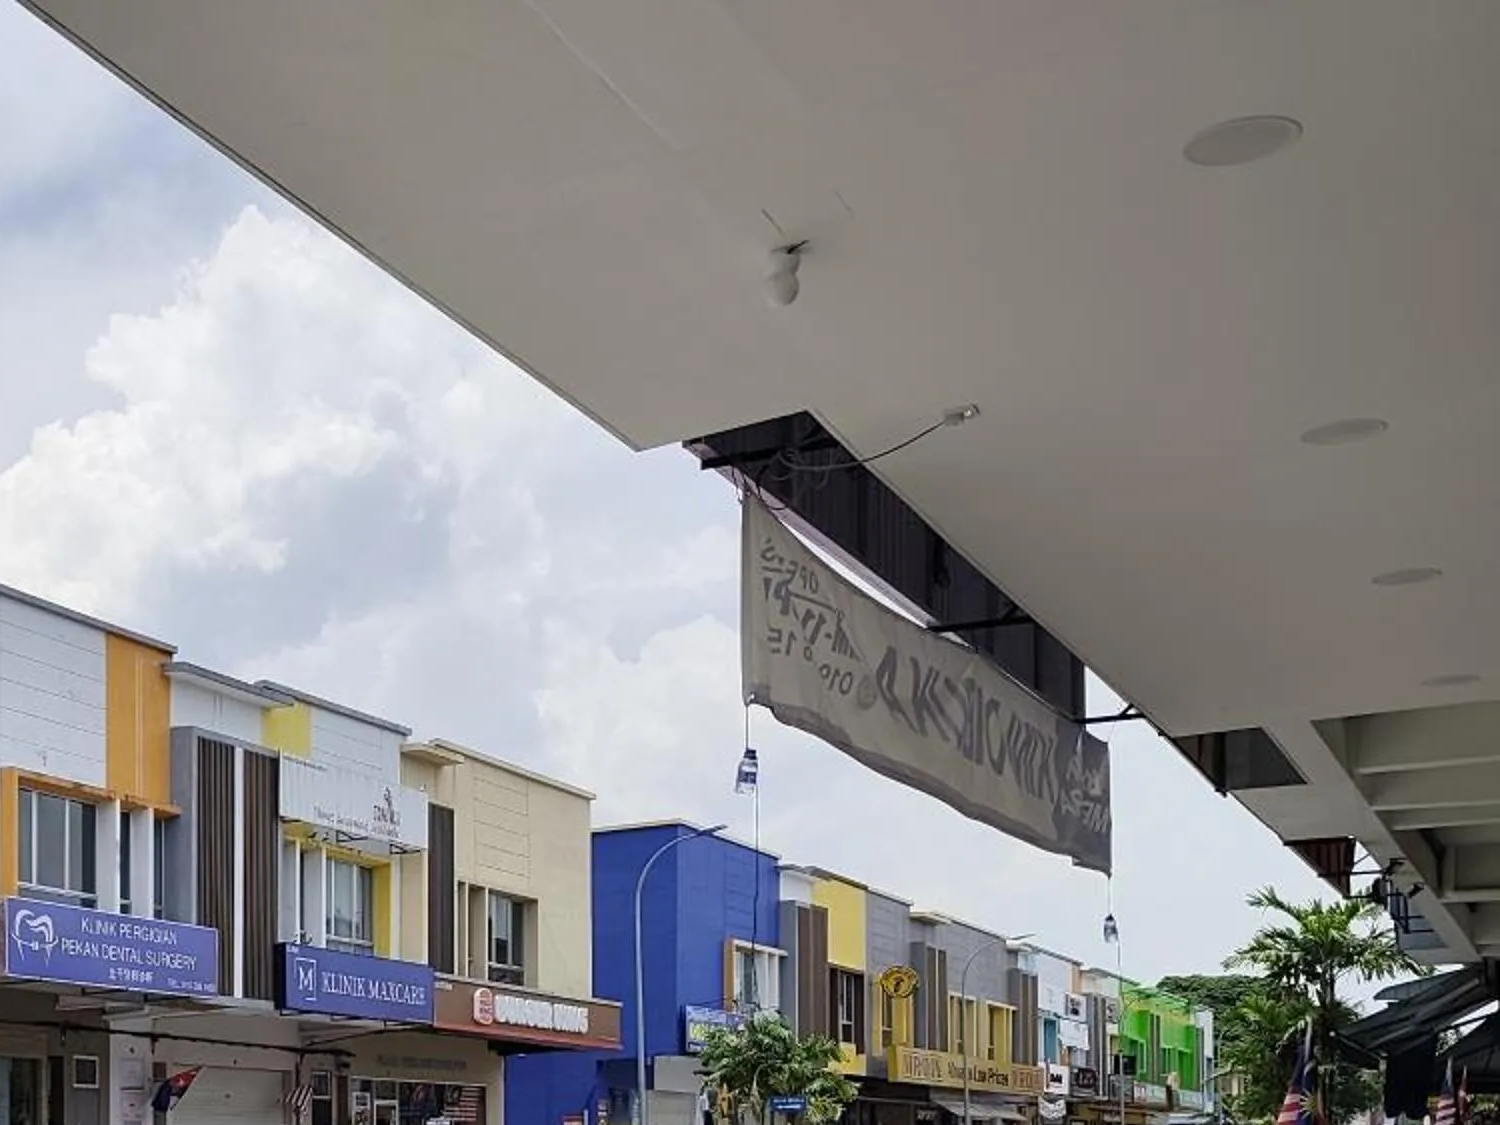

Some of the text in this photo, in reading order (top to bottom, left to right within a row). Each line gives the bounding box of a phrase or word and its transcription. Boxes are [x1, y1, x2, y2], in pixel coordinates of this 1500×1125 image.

[80, 917, 118, 937] KLINIK
[61, 938, 197, 971] PEKAN DENTAL SURGERY
[322, 972, 365, 997] KLINIK
